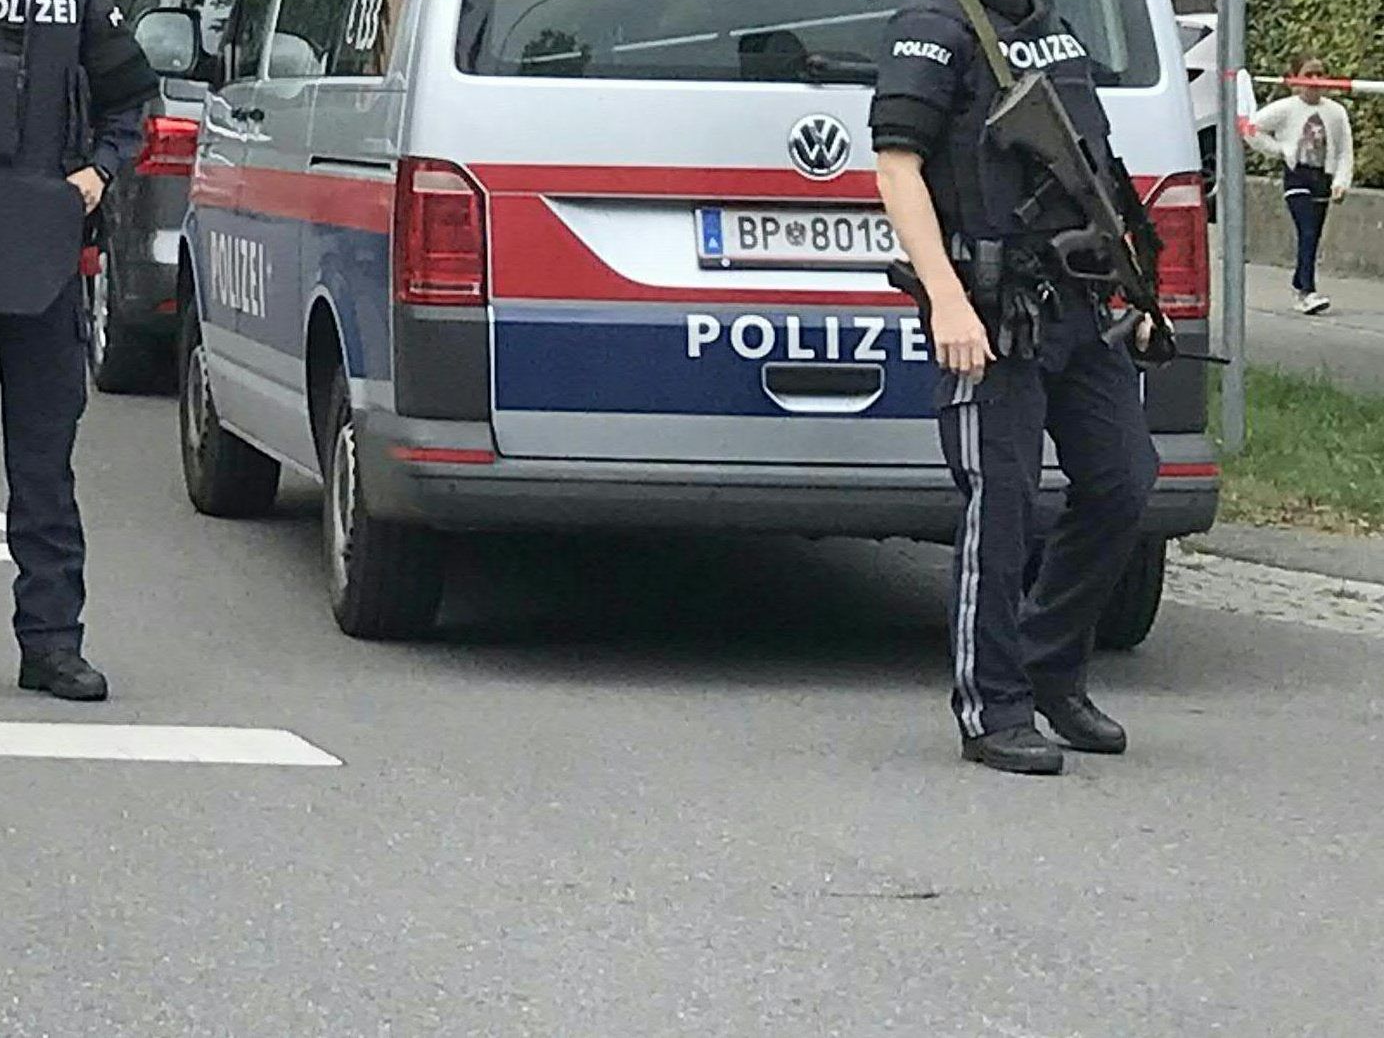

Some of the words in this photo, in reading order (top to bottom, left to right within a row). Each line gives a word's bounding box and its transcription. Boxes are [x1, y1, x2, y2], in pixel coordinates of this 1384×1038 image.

[893, 41, 952, 66] POLIZEI
[737, 216, 781, 251] BP
[811, 217, 895, 252] 8013
[210, 230, 266, 318] POLIZEI
[686, 315, 929, 361] POLIZE
